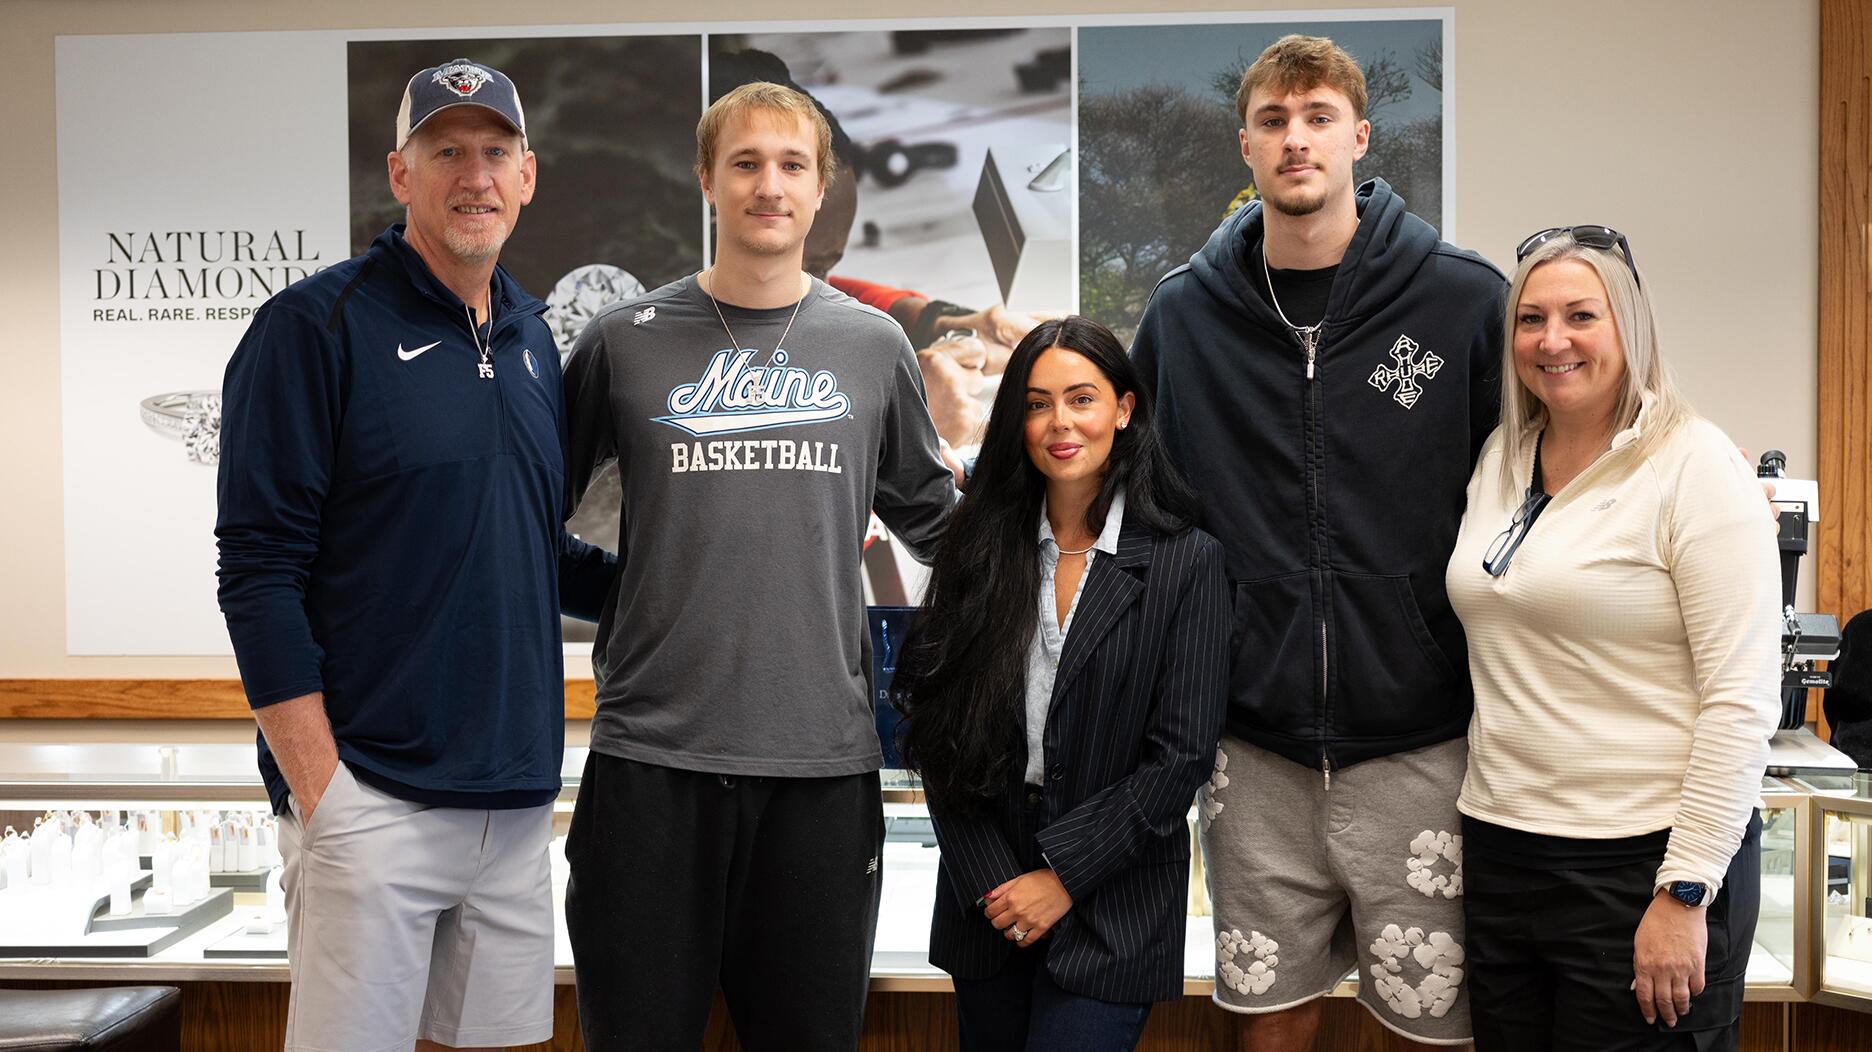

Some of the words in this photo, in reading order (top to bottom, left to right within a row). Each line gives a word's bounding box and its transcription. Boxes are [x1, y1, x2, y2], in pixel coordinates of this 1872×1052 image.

[106, 229, 320, 263] NATURAL
[93, 308, 143, 321] REAL.
[148, 308, 200, 321] RARE.
[667, 348, 851, 416] Maine
[670, 439, 842, 474] BASKETBALL
